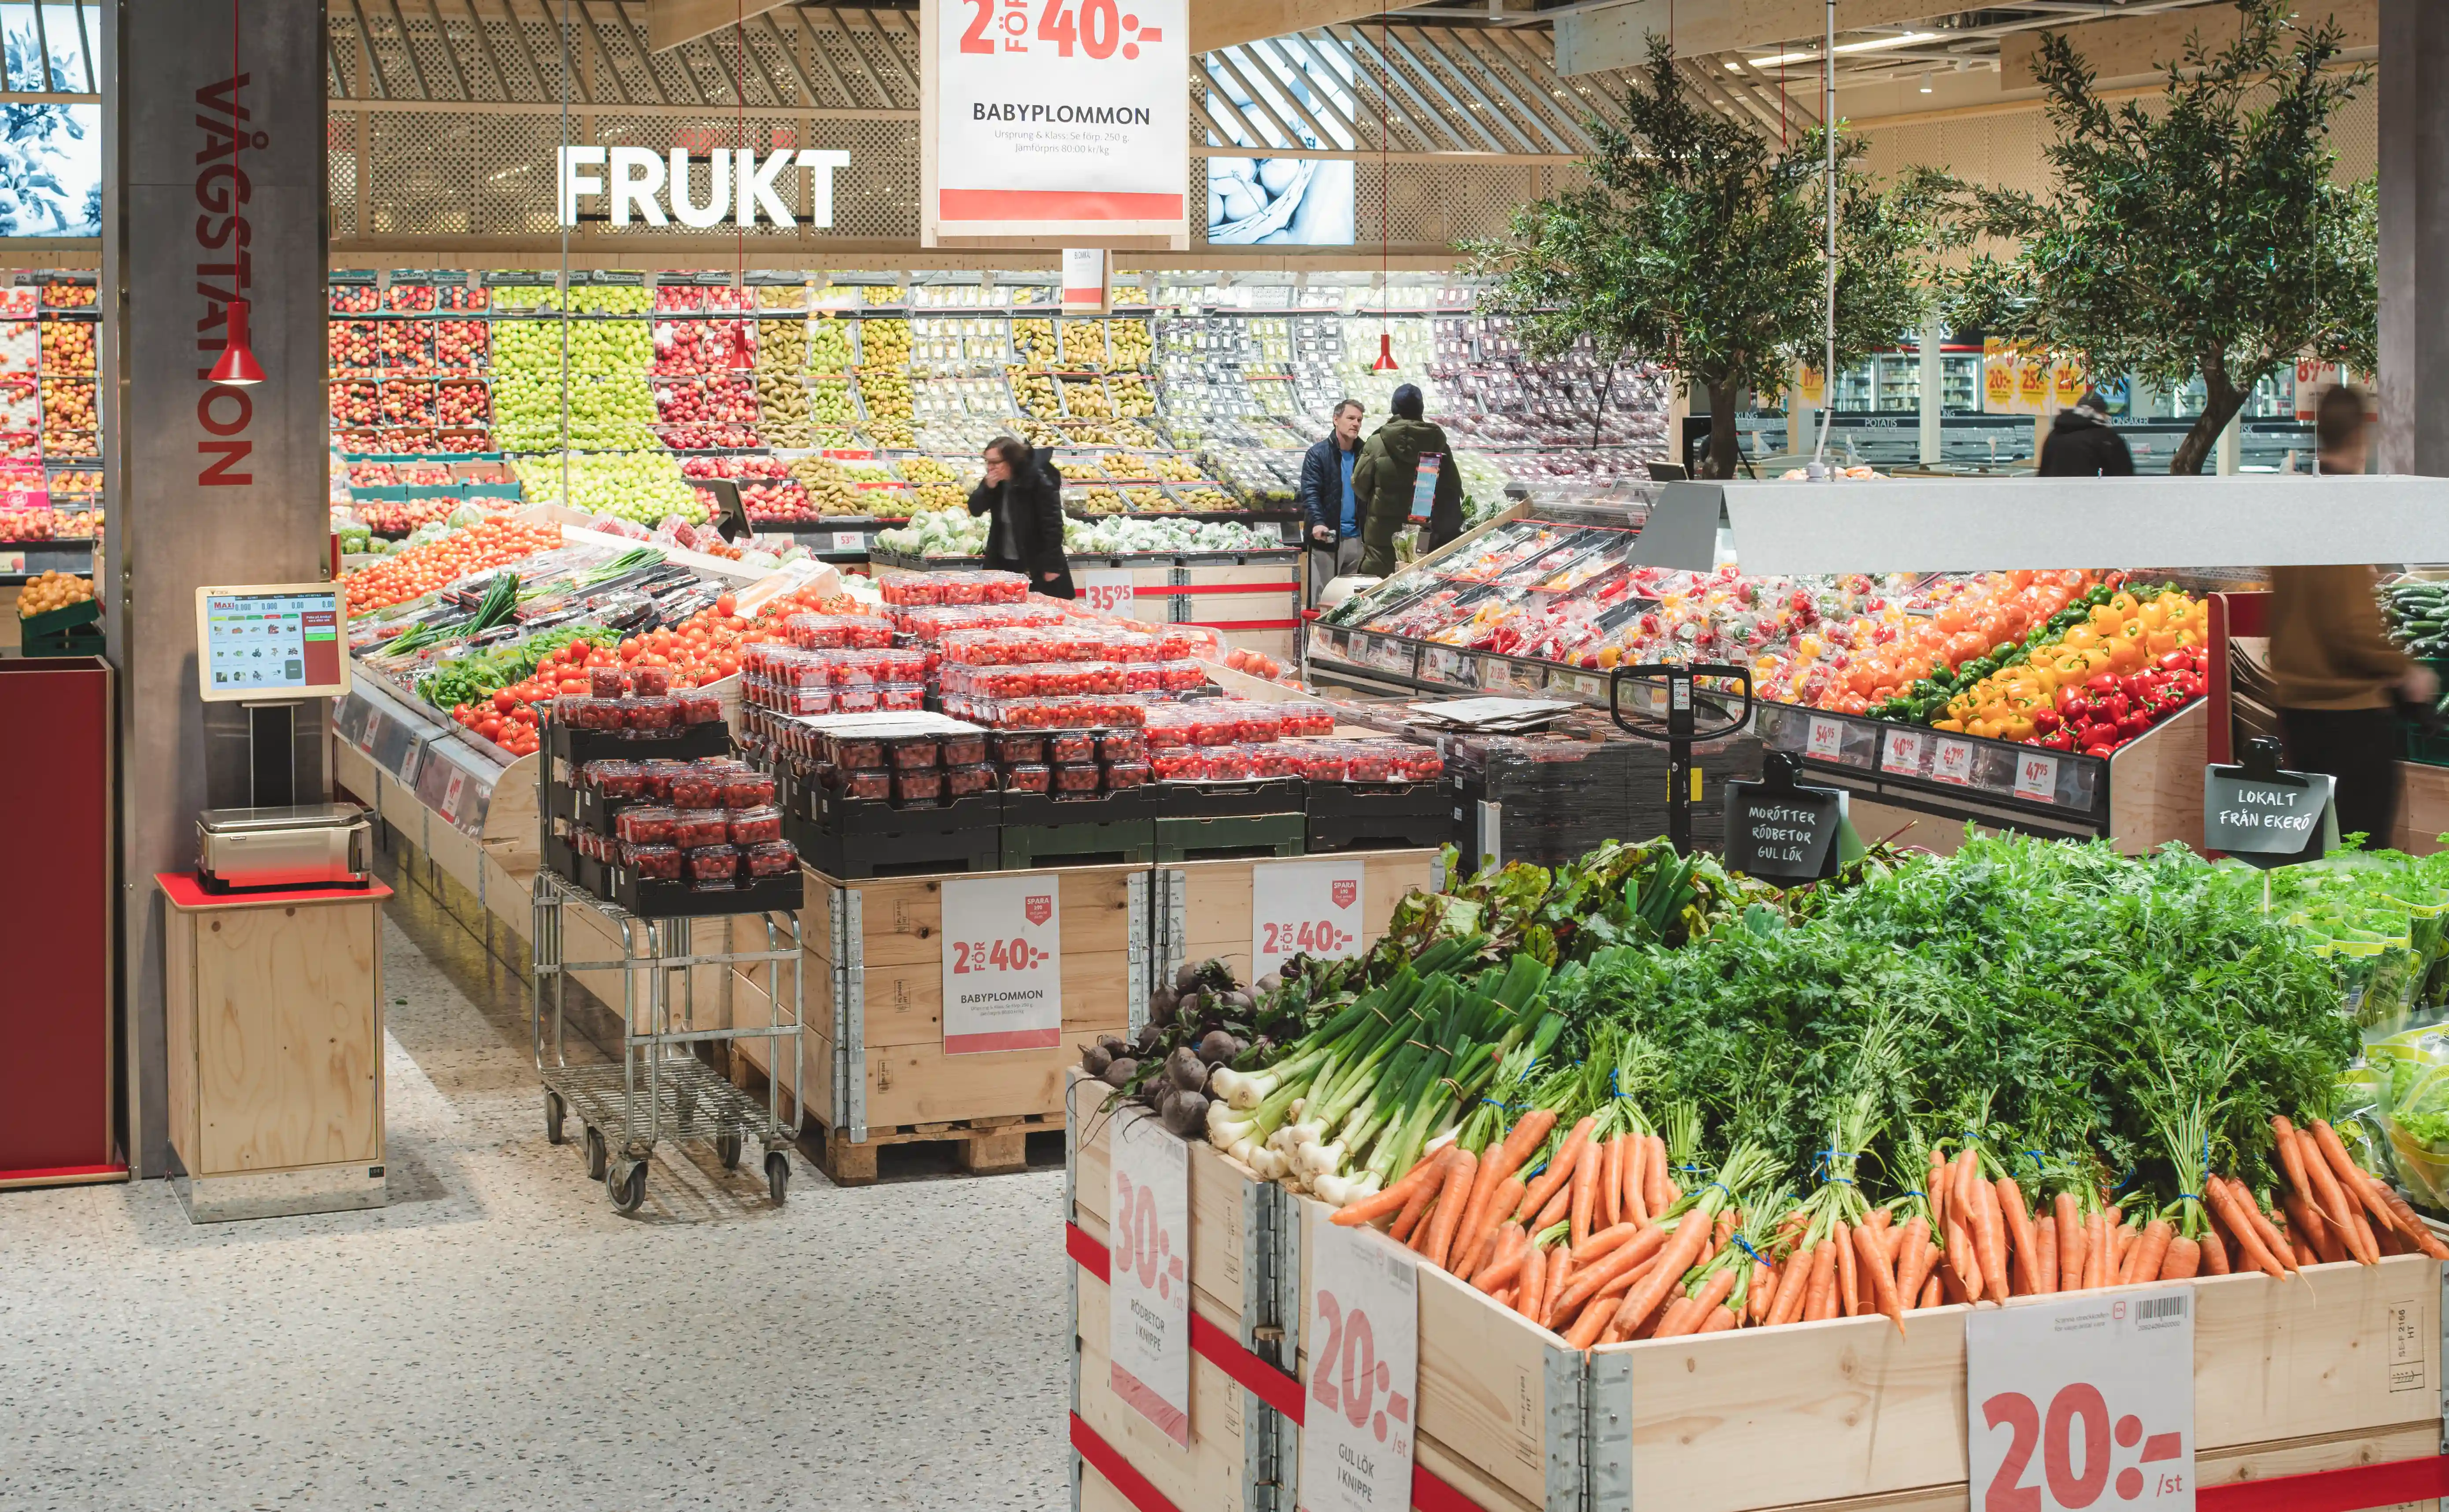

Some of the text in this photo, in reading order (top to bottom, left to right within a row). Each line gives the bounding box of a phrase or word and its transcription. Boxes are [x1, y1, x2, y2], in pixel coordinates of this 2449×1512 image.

[960, 0, 994, 54] 2
[1038, 0, 1162, 59] 40:-
[973, 103, 1150, 125] BABYPLOMMON
[994, 129, 1034, 141] Ursprung
[1083, 132, 1101, 143] förp.
[1104, 133, 1120, 141] 250
[1123, 134, 1130, 144] g.
[1015, 144, 1109, 156] Jämförpris 80:00 kr/kg
[557, 146, 850, 228] FRUKT
[196, 72, 269, 486] VÅGSTATON
[1989, 369, 2011, 389] 20:-
[1865, 419, 1897, 428] POTATIS
[2241, 424, 2253, 433] ISK
[2238, 789, 2298, 807] LOKALT
[1749, 805, 1816, 825] MORÖTTER
[2219, 808, 2312, 831] FRÅN EKERÖ
[1752, 823, 1811, 845] RÖDBETOR
[1758, 846, 1803, 862] GUL LÖK
[1263, 920, 1353, 954] 2 FÖR 40:-
[953, 938, 1049, 974] 2 FÖR 40:-
[960, 990, 1043, 1004] BABYPLOMMON
[1115, 1170, 1184, 1300] 30:-
[1173, 1290, 1183, 1311] /st
[1131, 1298, 1165, 1334] RÖDBETOR
[1139, 1325, 1161, 1352] KNIPPE
[2407, 1325, 2414, 1339] HT
[1312, 1289, 1409, 1443] 20:-
[1392, 1431, 1407, 1458] /st
[1981, 1382, 2182, 1512] 20:-
[1339, 1443, 1374, 1479] GUL LÖK
[1337, 1466, 1341, 1482] I
[1342, 1469, 1372, 1504] KNIPPE
[2156, 1473, 2183, 1498] /st
